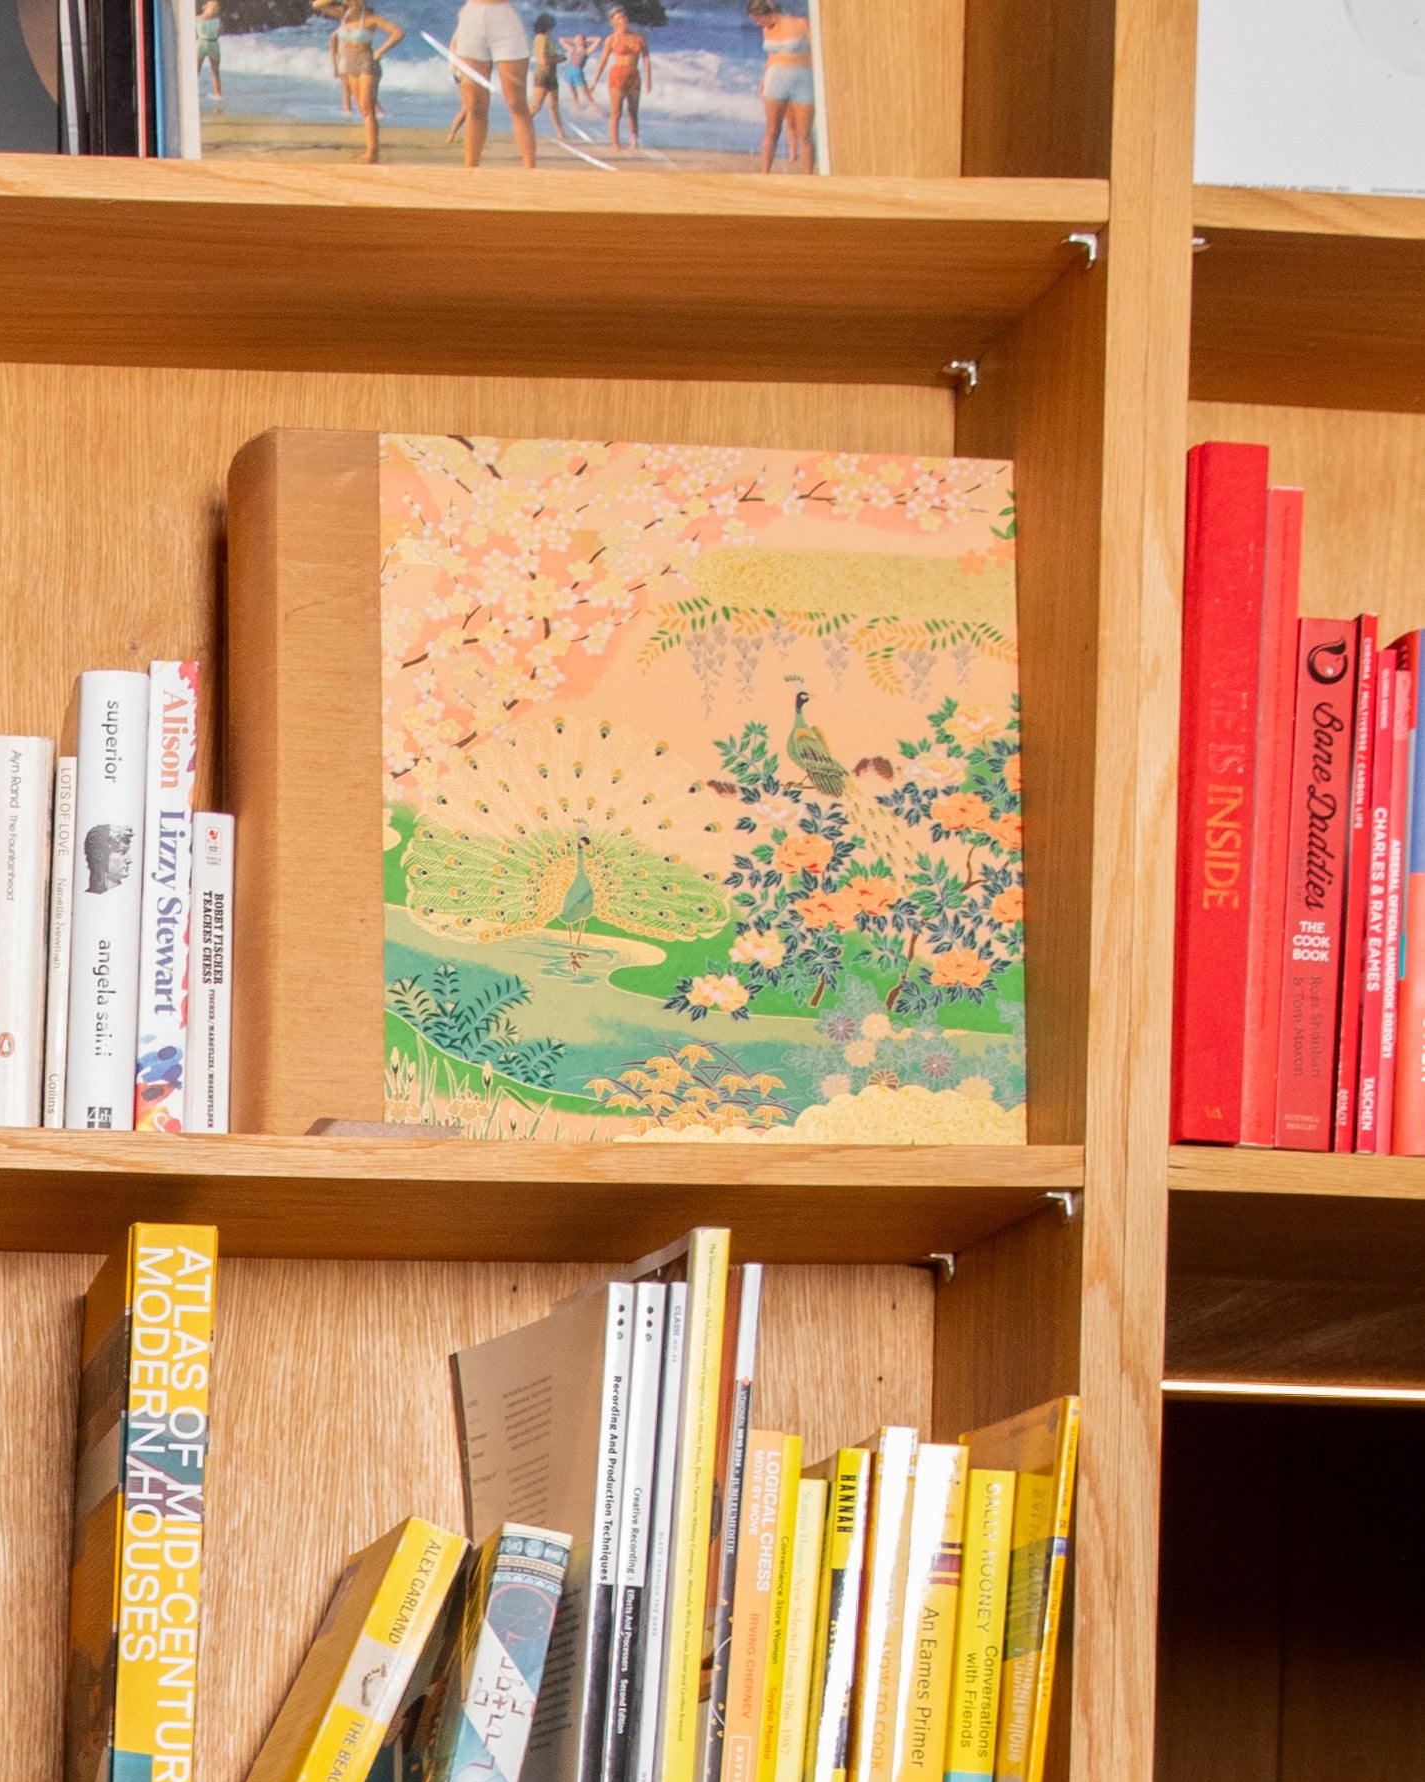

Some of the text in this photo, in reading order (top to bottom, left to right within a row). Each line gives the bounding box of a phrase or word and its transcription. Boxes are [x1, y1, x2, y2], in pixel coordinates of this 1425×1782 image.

[104, 700, 121, 783] superior
[152, 689, 188, 1015] Alison Lizzy Stewart
[1306, 700, 1346, 911] Bone Daddies
[94, 940, 114, 1005] angela
[202, 891, 213, 984] TEACHES CHESS
[212, 893, 224, 984] BOBBY FISCHER
[1361, 807, 1389, 1131] CHARLES & RAY EAMES TASCHEN
[171, 1245, 212, 1391] ATLAS
[120, 1248, 170, 1662] MODERN HOUSES
[169, 1405, 205, 1467] OF
[417, 1540, 440, 1578] ALEX
[388, 1578, 432, 1645] GARLAND
[910, 1607, 940, 1768] An Eames Primer
[959, 1652, 980, 1747] with Friends
[977, 1645, 999, 1757] Conversations
[341, 1720, 366, 1751] THE
